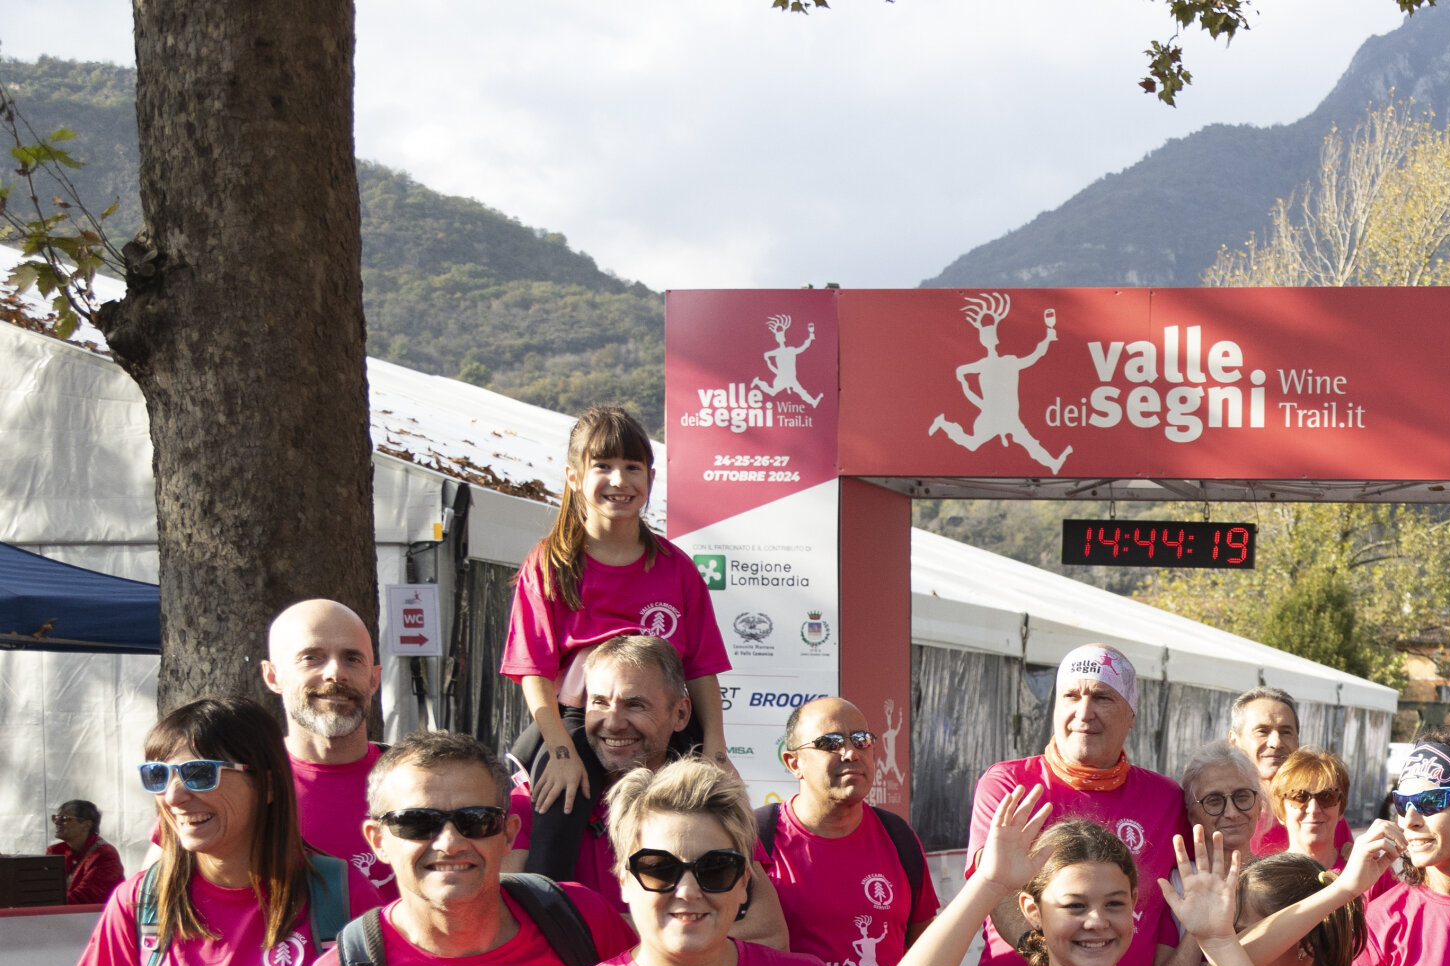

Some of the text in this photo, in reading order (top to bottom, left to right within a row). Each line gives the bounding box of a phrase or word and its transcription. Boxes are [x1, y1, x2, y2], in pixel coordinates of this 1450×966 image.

[1088, 325, 1244, 383] valle
[1277, 369, 1347, 395] Wine
[698, 383, 763, 408] valle
[776, 401, 805, 413] Wine
[777, 416, 813, 427] Trail.it
[1278, 402, 1365, 428] Trail.it
[713, 455, 790, 466] 24-25-26-27
[703, 470, 800, 482] OTTOBRE 2024
[731, 560, 791, 575] Regione
[731, 575, 810, 587] Lombardia
[404, 614, 424, 624] WC
[749, 692, 828, 707] BROOK
